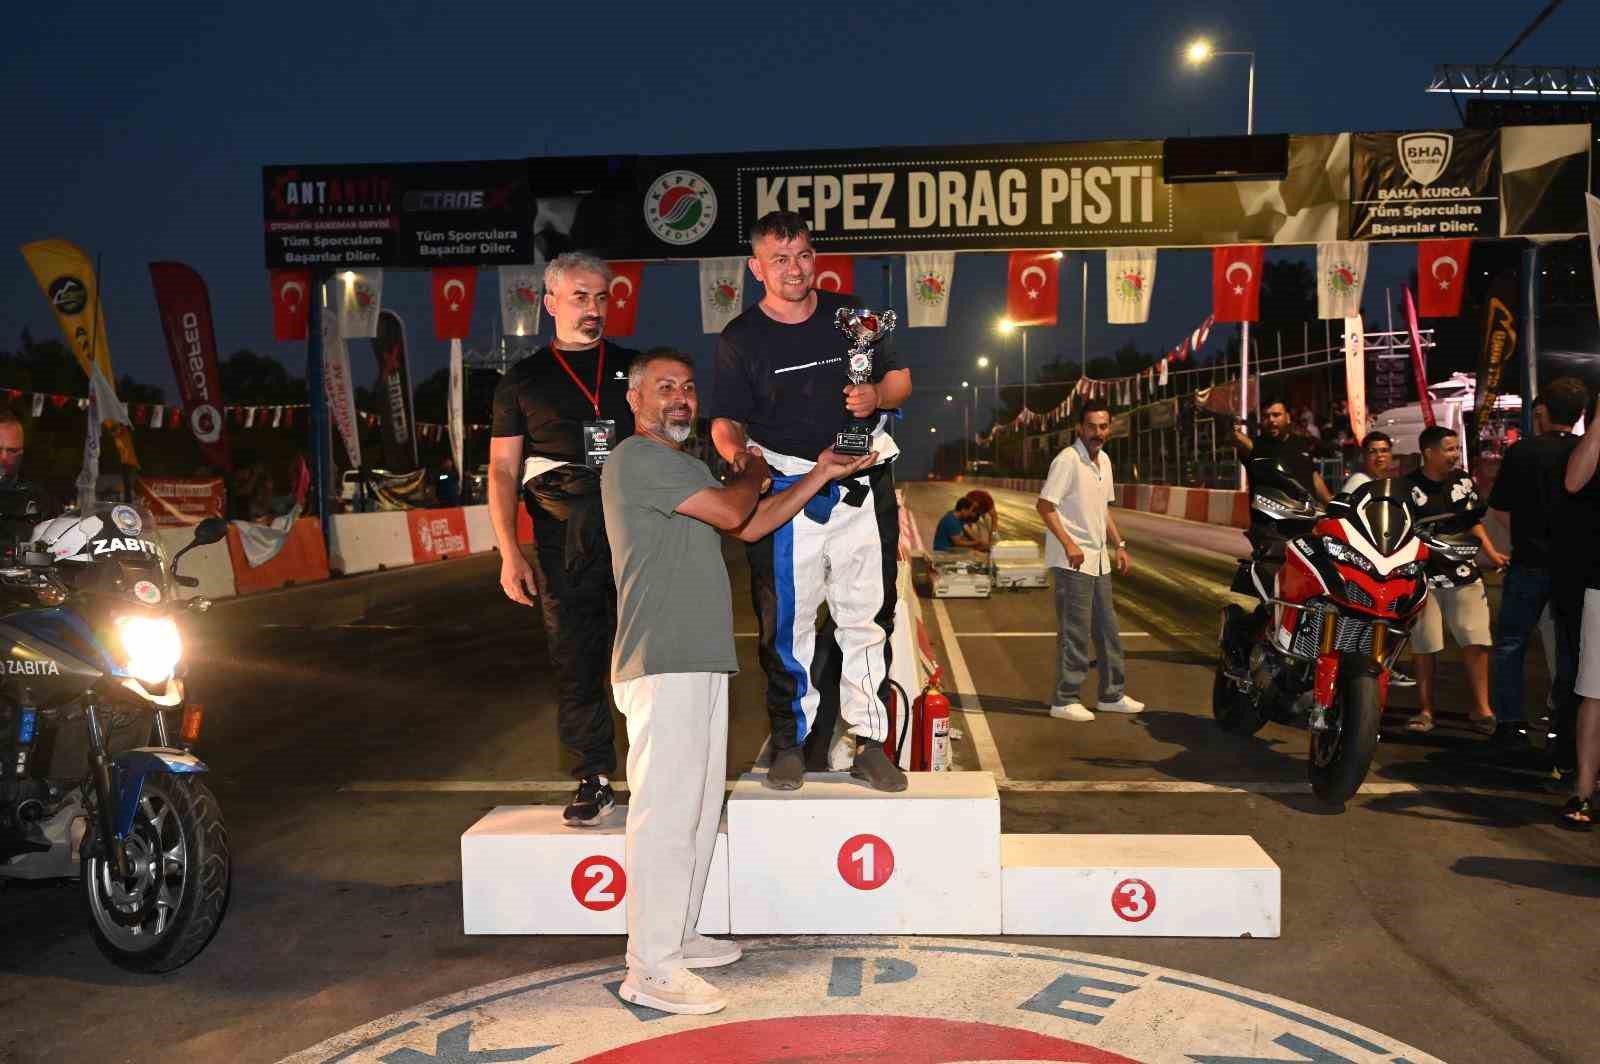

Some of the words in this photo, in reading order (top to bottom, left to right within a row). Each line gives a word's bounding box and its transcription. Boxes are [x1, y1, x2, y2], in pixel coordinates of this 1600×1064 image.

[1407, 146, 1443, 158] BHA
[756, 172, 896, 231] KEPEZ
[908, 169, 1028, 228] DRAG
[1378, 188, 1418, 200] BAHA
[1422, 186, 1471, 198] KURGA
[1368, 205, 1400, 218] Tüm
[1404, 204, 1482, 218] Sporculara
[1439, 221, 1479, 233] Diler.
[281, 236, 310, 247] Tüm
[313, 235, 383, 248] Sporculara
[416, 231, 445, 242] Tüm
[448, 229, 518, 242] Sporculara
[480, 242, 515, 254] Diler.
[346, 250, 380, 262] Diler.
[6, 660, 60, 675] ZABITA
[851, 842, 875, 881] 1
[583, 864, 617, 902] 2
[1119, 882, 1149, 918] 3
